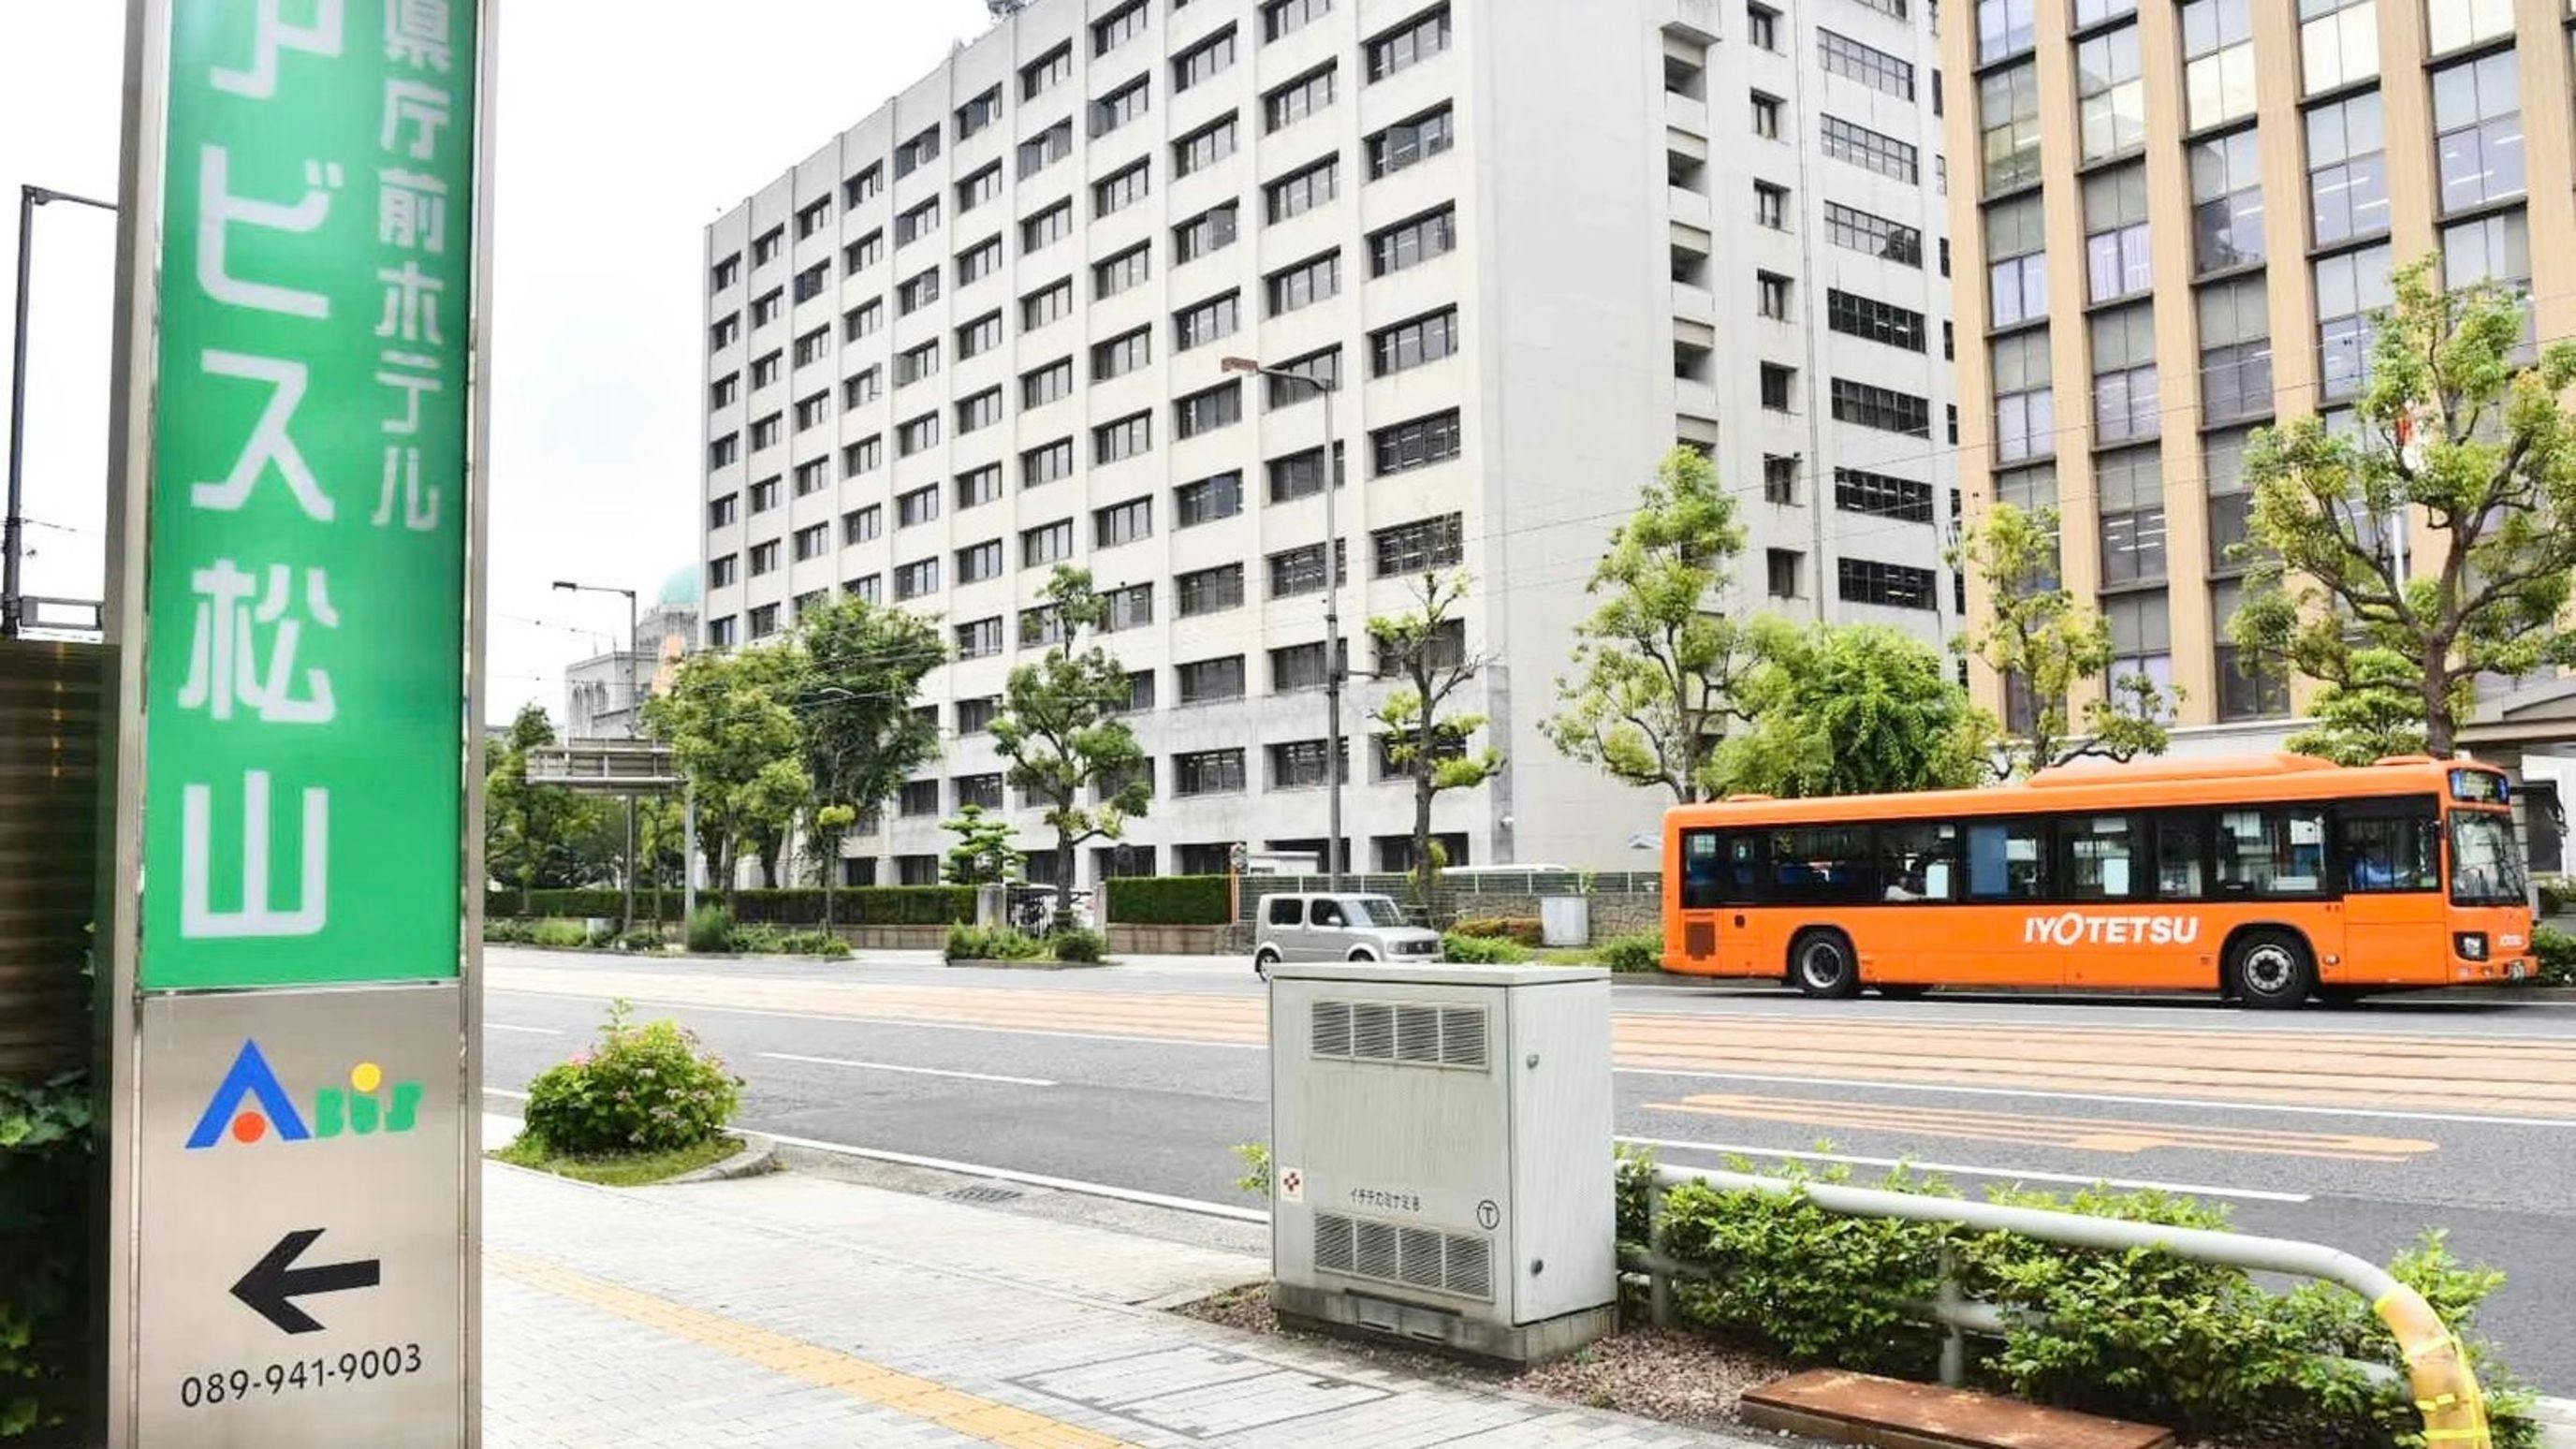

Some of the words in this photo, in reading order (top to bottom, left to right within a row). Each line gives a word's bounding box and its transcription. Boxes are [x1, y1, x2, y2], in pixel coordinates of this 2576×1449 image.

[371, 0, 453, 533] 県庁前ホテル
[2024, 912, 2198, 946] IYOTETSU
[181, 1342, 422, 1408] 089-941-9003
